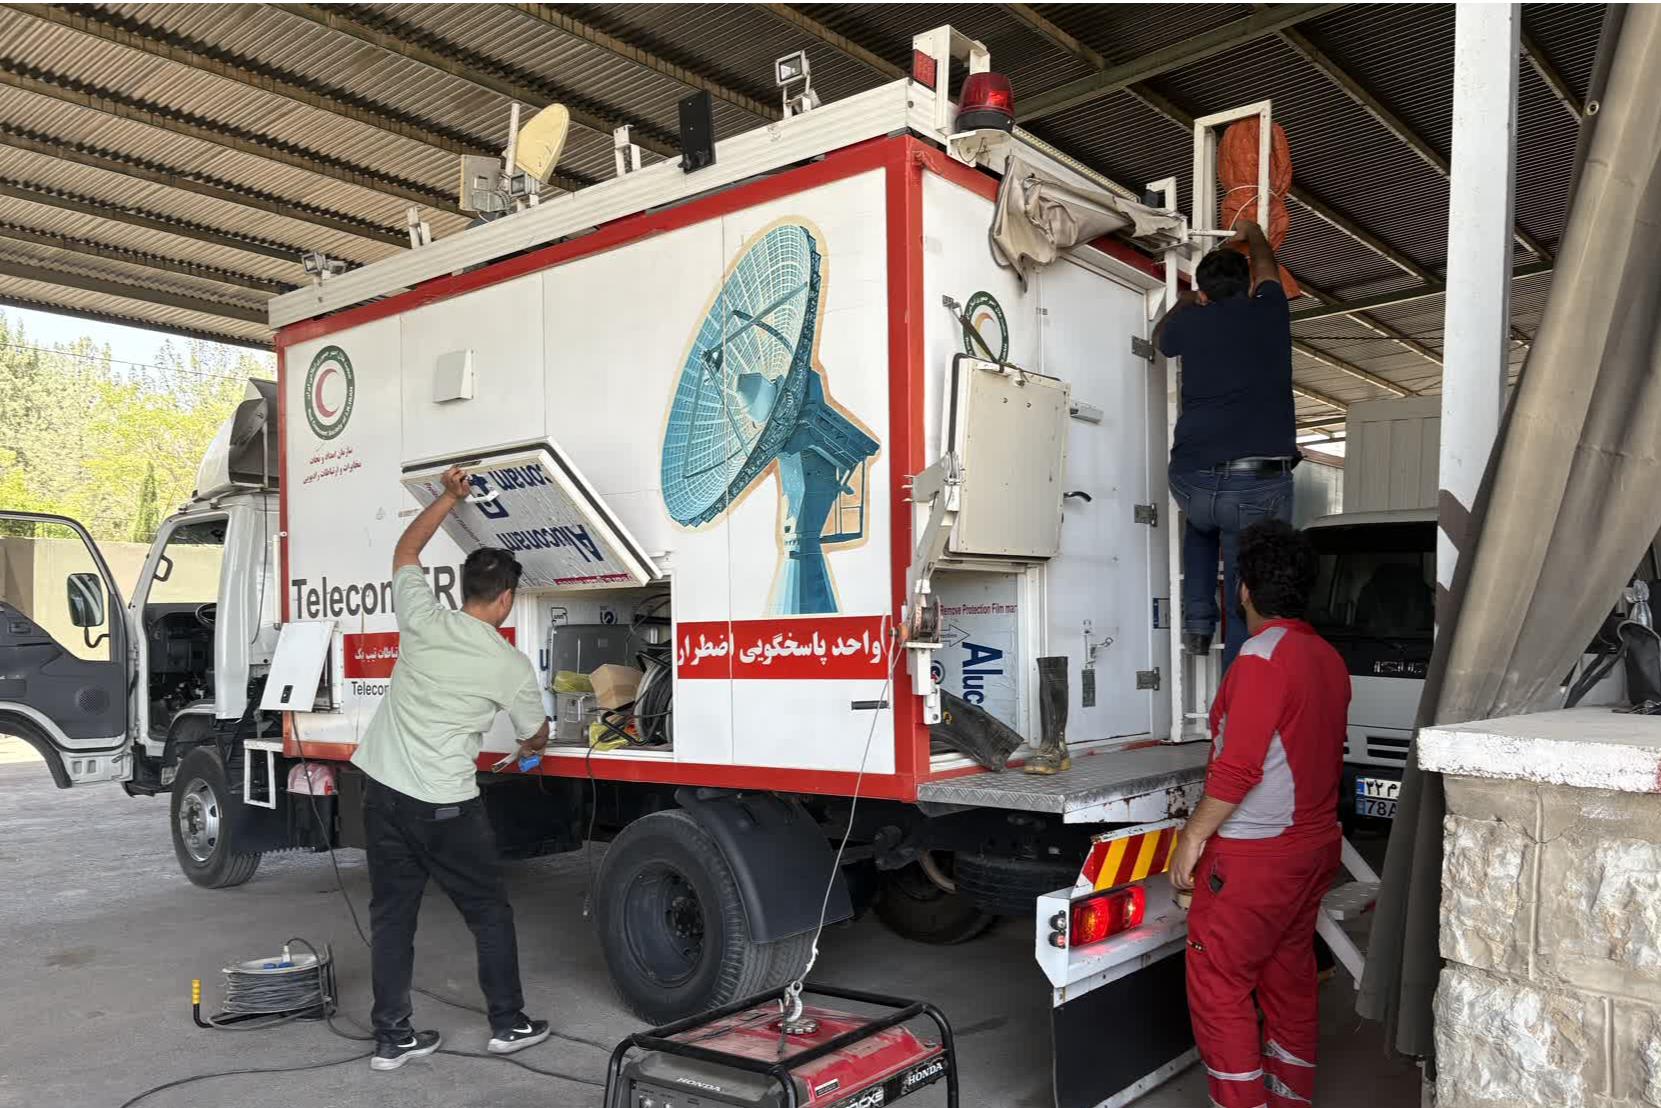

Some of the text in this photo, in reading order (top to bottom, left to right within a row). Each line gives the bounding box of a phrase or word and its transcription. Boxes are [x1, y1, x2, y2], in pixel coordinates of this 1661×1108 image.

[739, 630, 827, 666] پاسخگویی
[831, 629, 882, 664] واحد
[676, 1077, 721, 1092] HONDA
[906, 1062, 944, 1086] HONDA
